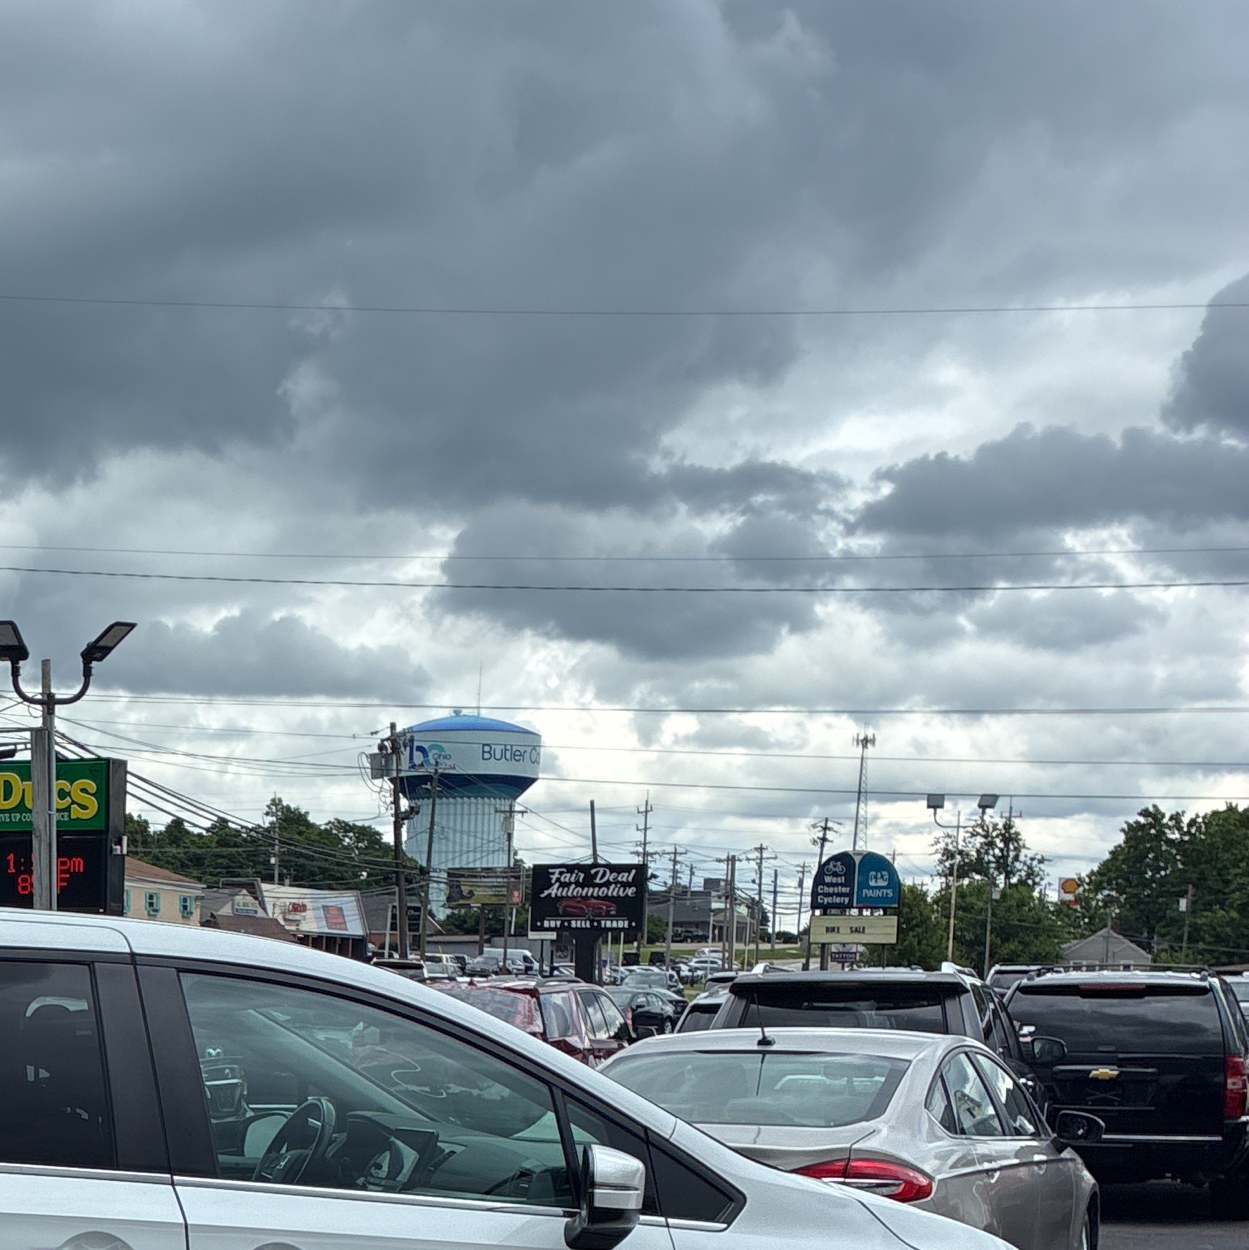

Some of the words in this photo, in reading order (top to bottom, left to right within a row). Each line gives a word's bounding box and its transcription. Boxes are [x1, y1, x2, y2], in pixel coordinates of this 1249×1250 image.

[481, 743, 527, 763] Butler
[11, 813, 21, 822] UP
[6, 853, 84, 873] 1:pm
[548, 867, 585, 884] Fair
[590, 867, 636, 884] Deal
[823, 875, 846, 884] West
[539, 882, 637, 898] Automotive
[817, 885, 851, 894] Chester
[862, 888, 893, 898] PAINTS
[817, 895, 850, 905] Cyclery
[543, 920, 562, 929] BUY
[571, 920, 591, 929] SELL
[600, 920, 629, 929] TRADE
[825, 926, 841, 934] BIKE
[849, 926, 866, 934] SALE
